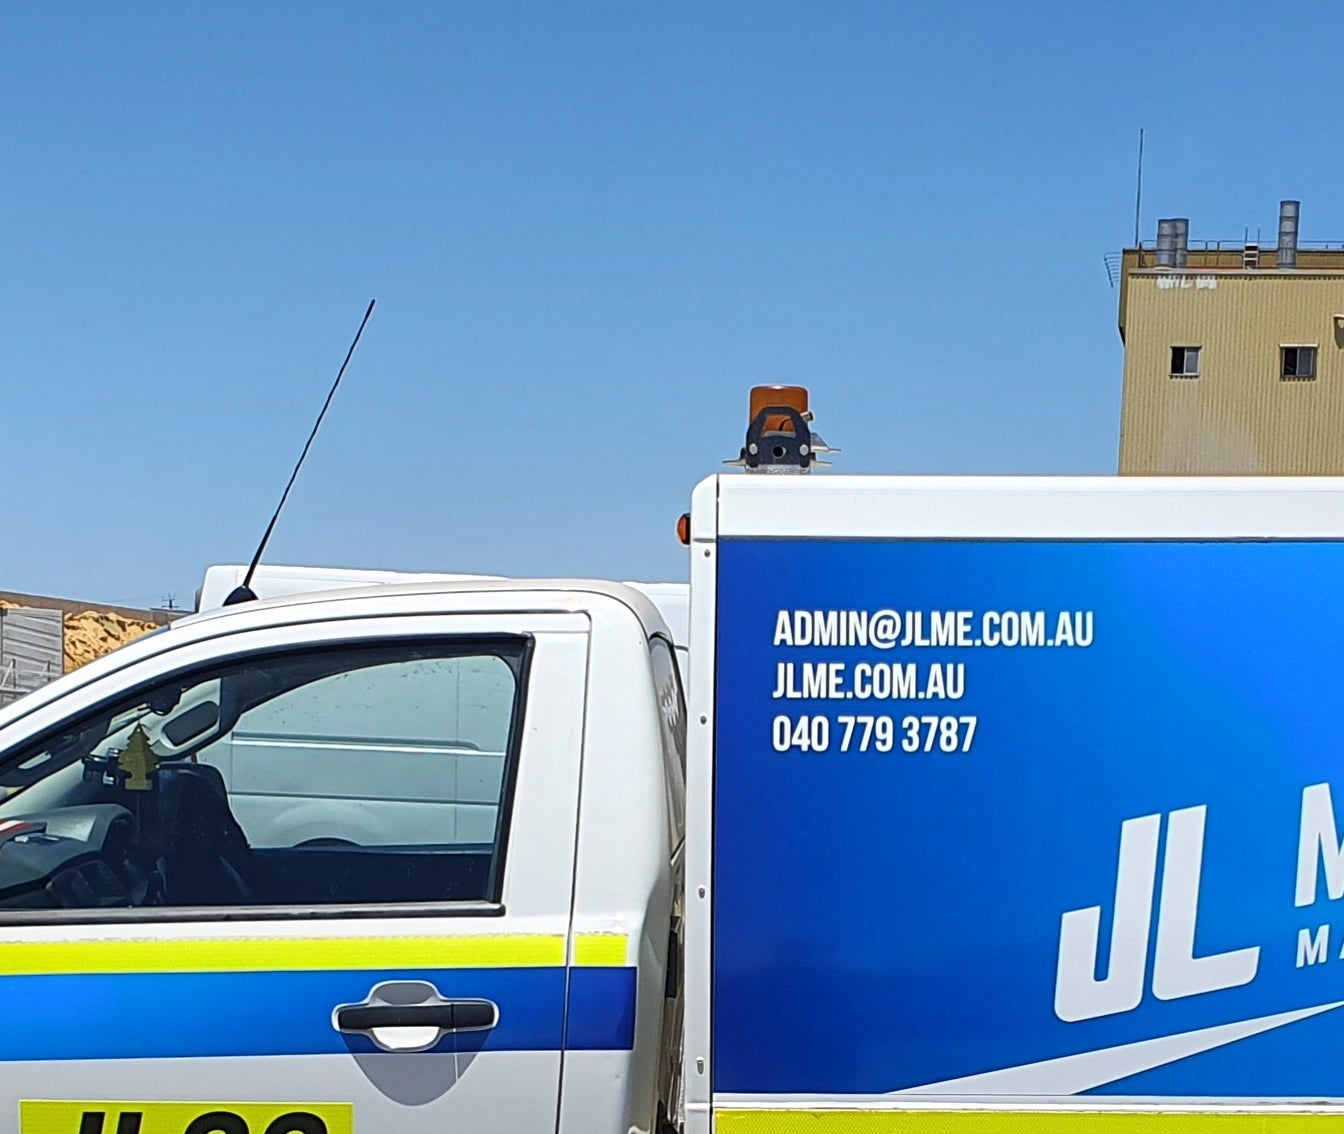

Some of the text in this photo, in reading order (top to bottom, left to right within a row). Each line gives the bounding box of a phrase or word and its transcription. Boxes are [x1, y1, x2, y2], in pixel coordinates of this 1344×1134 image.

[773, 609, 1094, 649] ADMIN@JLME.COM.AU
[772, 663, 965, 700] JLME.COM.AU
[773, 715, 977, 752] 040 779 3787
[1054, 804, 1261, 1023] JL
